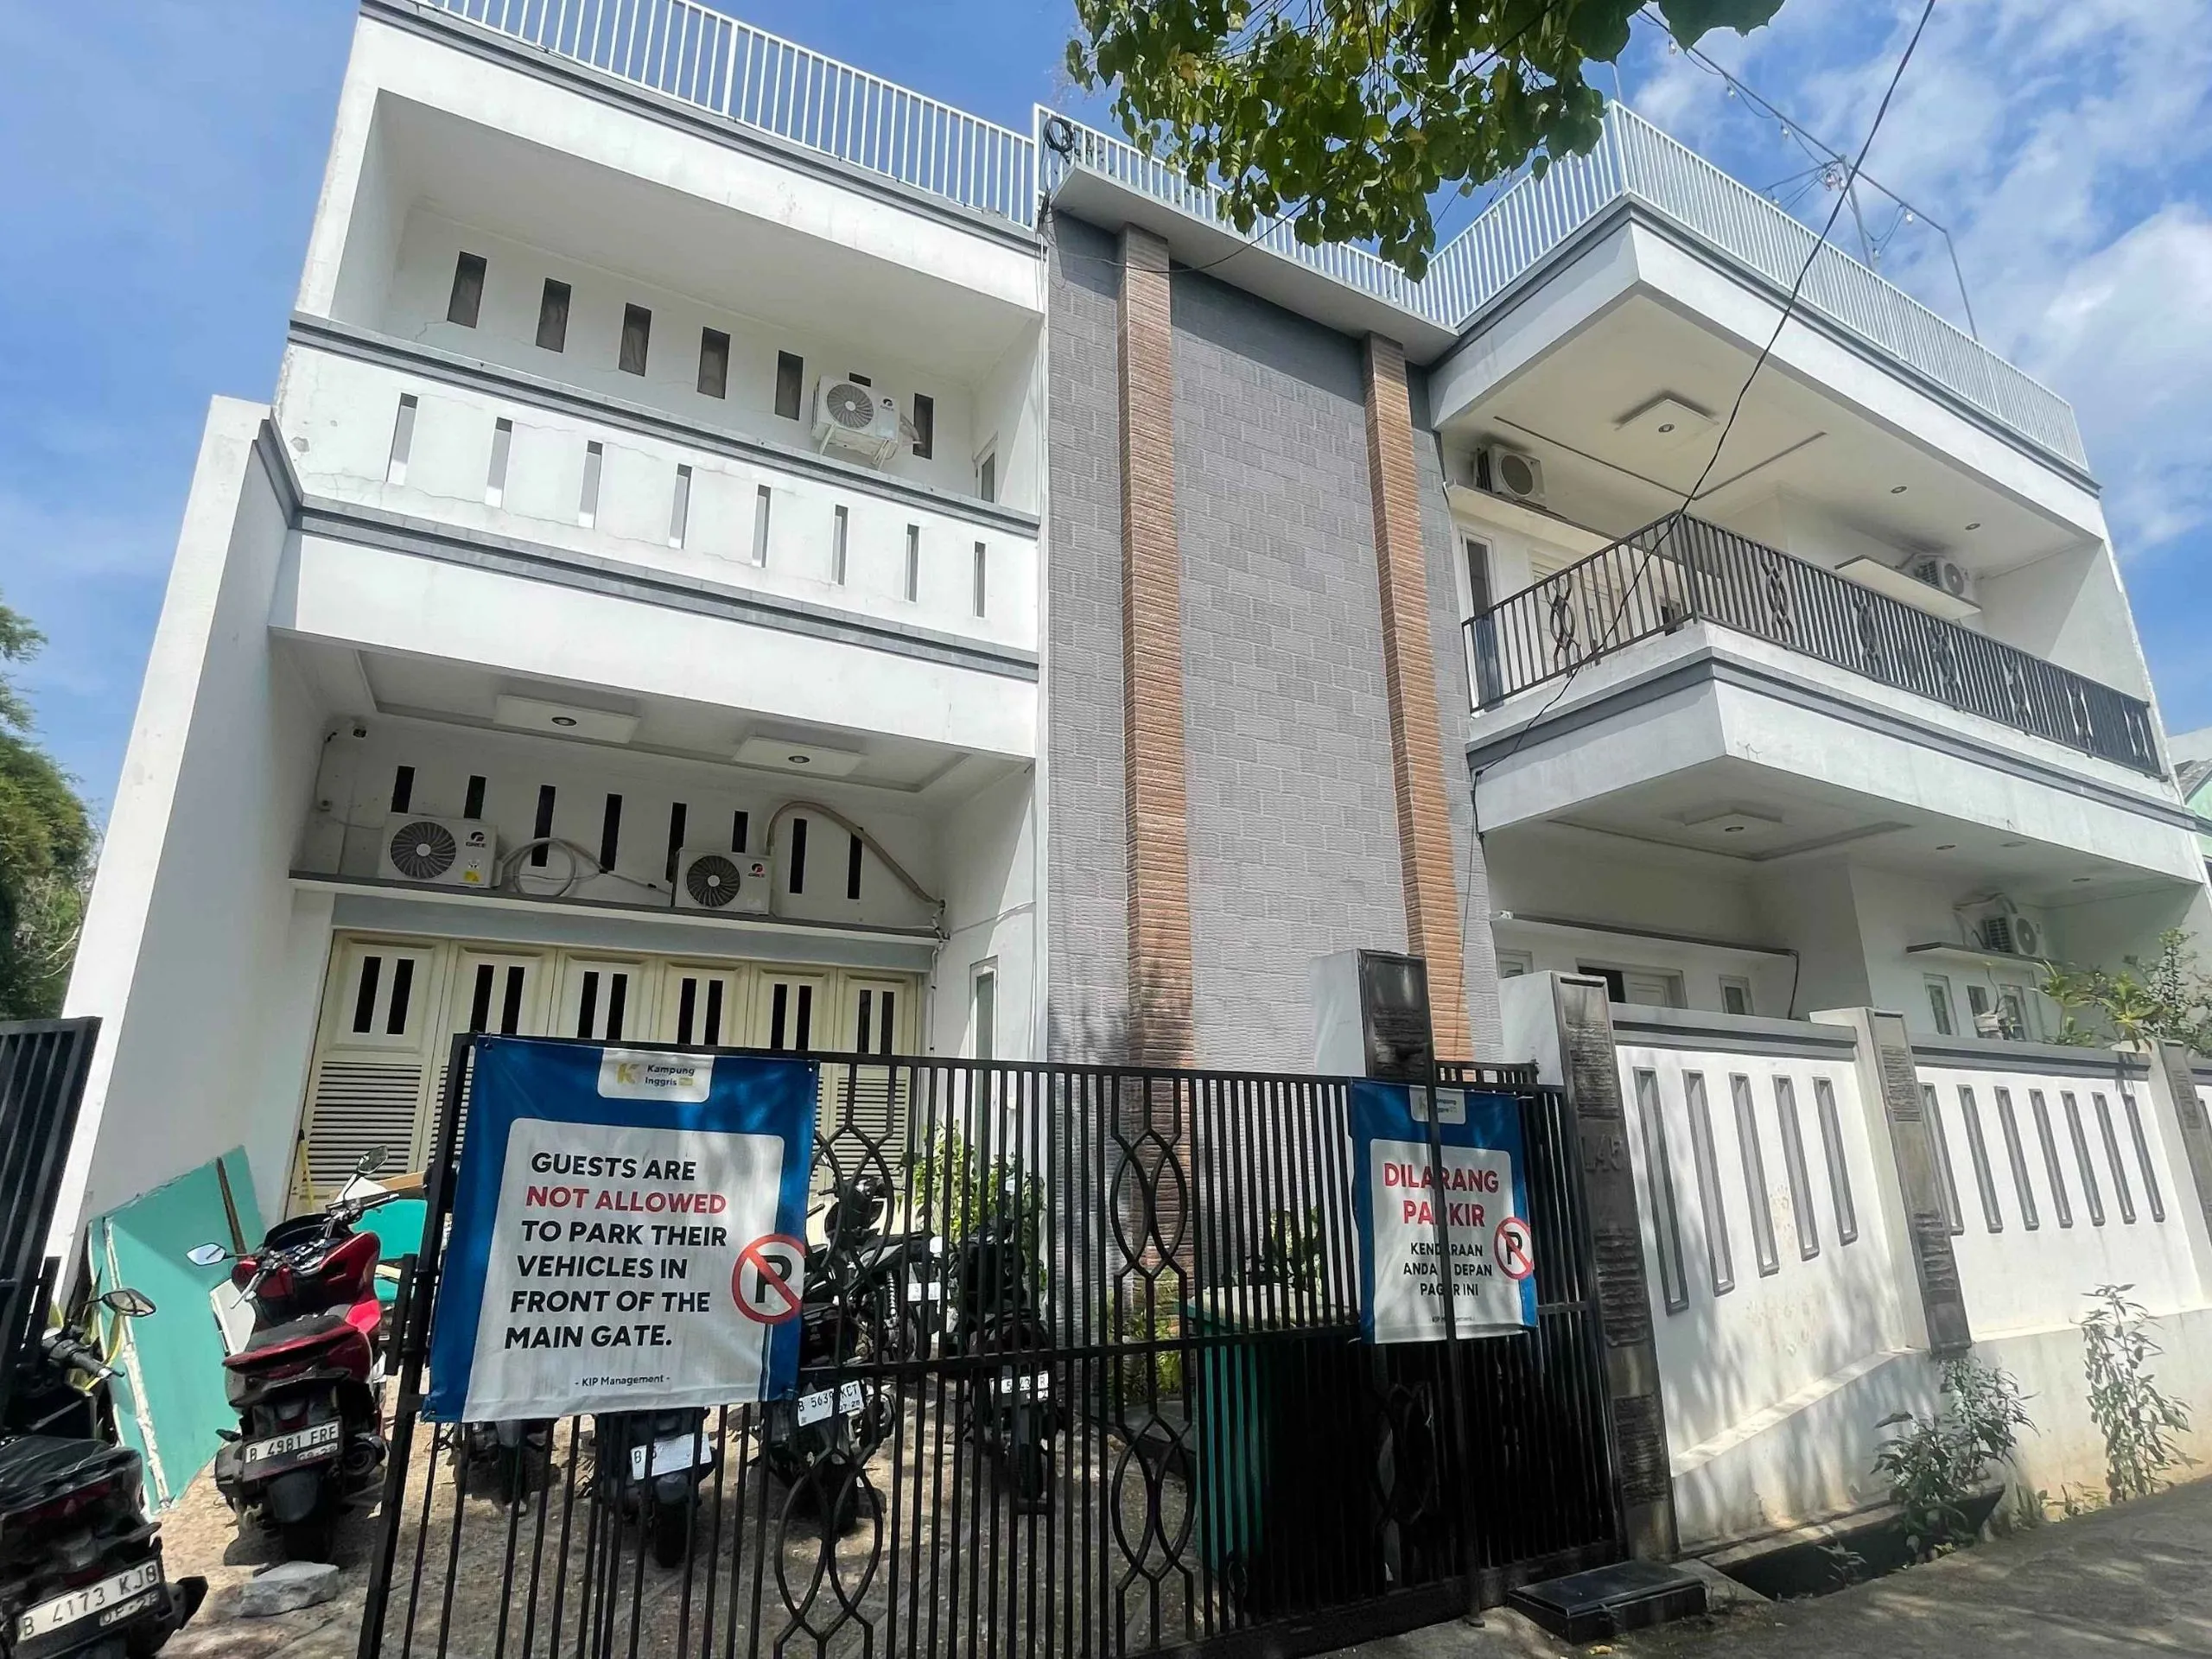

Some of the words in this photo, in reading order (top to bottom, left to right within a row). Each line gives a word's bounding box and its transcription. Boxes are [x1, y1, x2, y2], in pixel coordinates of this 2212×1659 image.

[645, 1077, 677, 1087] Inggris
[647, 1064, 696, 1077] Kampung
[531, 1152, 638, 1179] GUESTS
[643, 1160, 696, 1181] ARE
[1384, 1162, 1499, 1193] DILARANG
[525, 1185, 589, 1208] NOT
[594, 1190, 727, 1214] ALLOWED
[1403, 1199, 1485, 1227] PAKIR
[521, 1220, 562, 1243] TO
[569, 1222, 645, 1245] PARK
[651, 1225, 728, 1247] THEIR
[1410, 1243, 1484, 1256] KENDRAAN
[517, 1255, 654, 1279] VEHICLES
[660, 1258, 688, 1279] IN
[1403, 1262, 1438, 1275] ANDA
[1453, 1263, 1492, 1276] DEPAN
[1420, 1283, 1460, 1296] PAGR
[1463, 1283, 1478, 1296] INI
[510, 1290, 610, 1313] FRONT
[616, 1290, 654, 1312] OF
[661, 1292, 710, 1313] THE
[505, 1325, 584, 1349] MAIN
[591, 1325, 672, 1347] GATE.
[582, 1377, 598, 1387] KIP
[601, 1374, 664, 1386] Management
[267, 1435, 302, 1455] 4981
[22, 1617, 35, 1637] B
[52, 1586, 105, 1624] 4173
